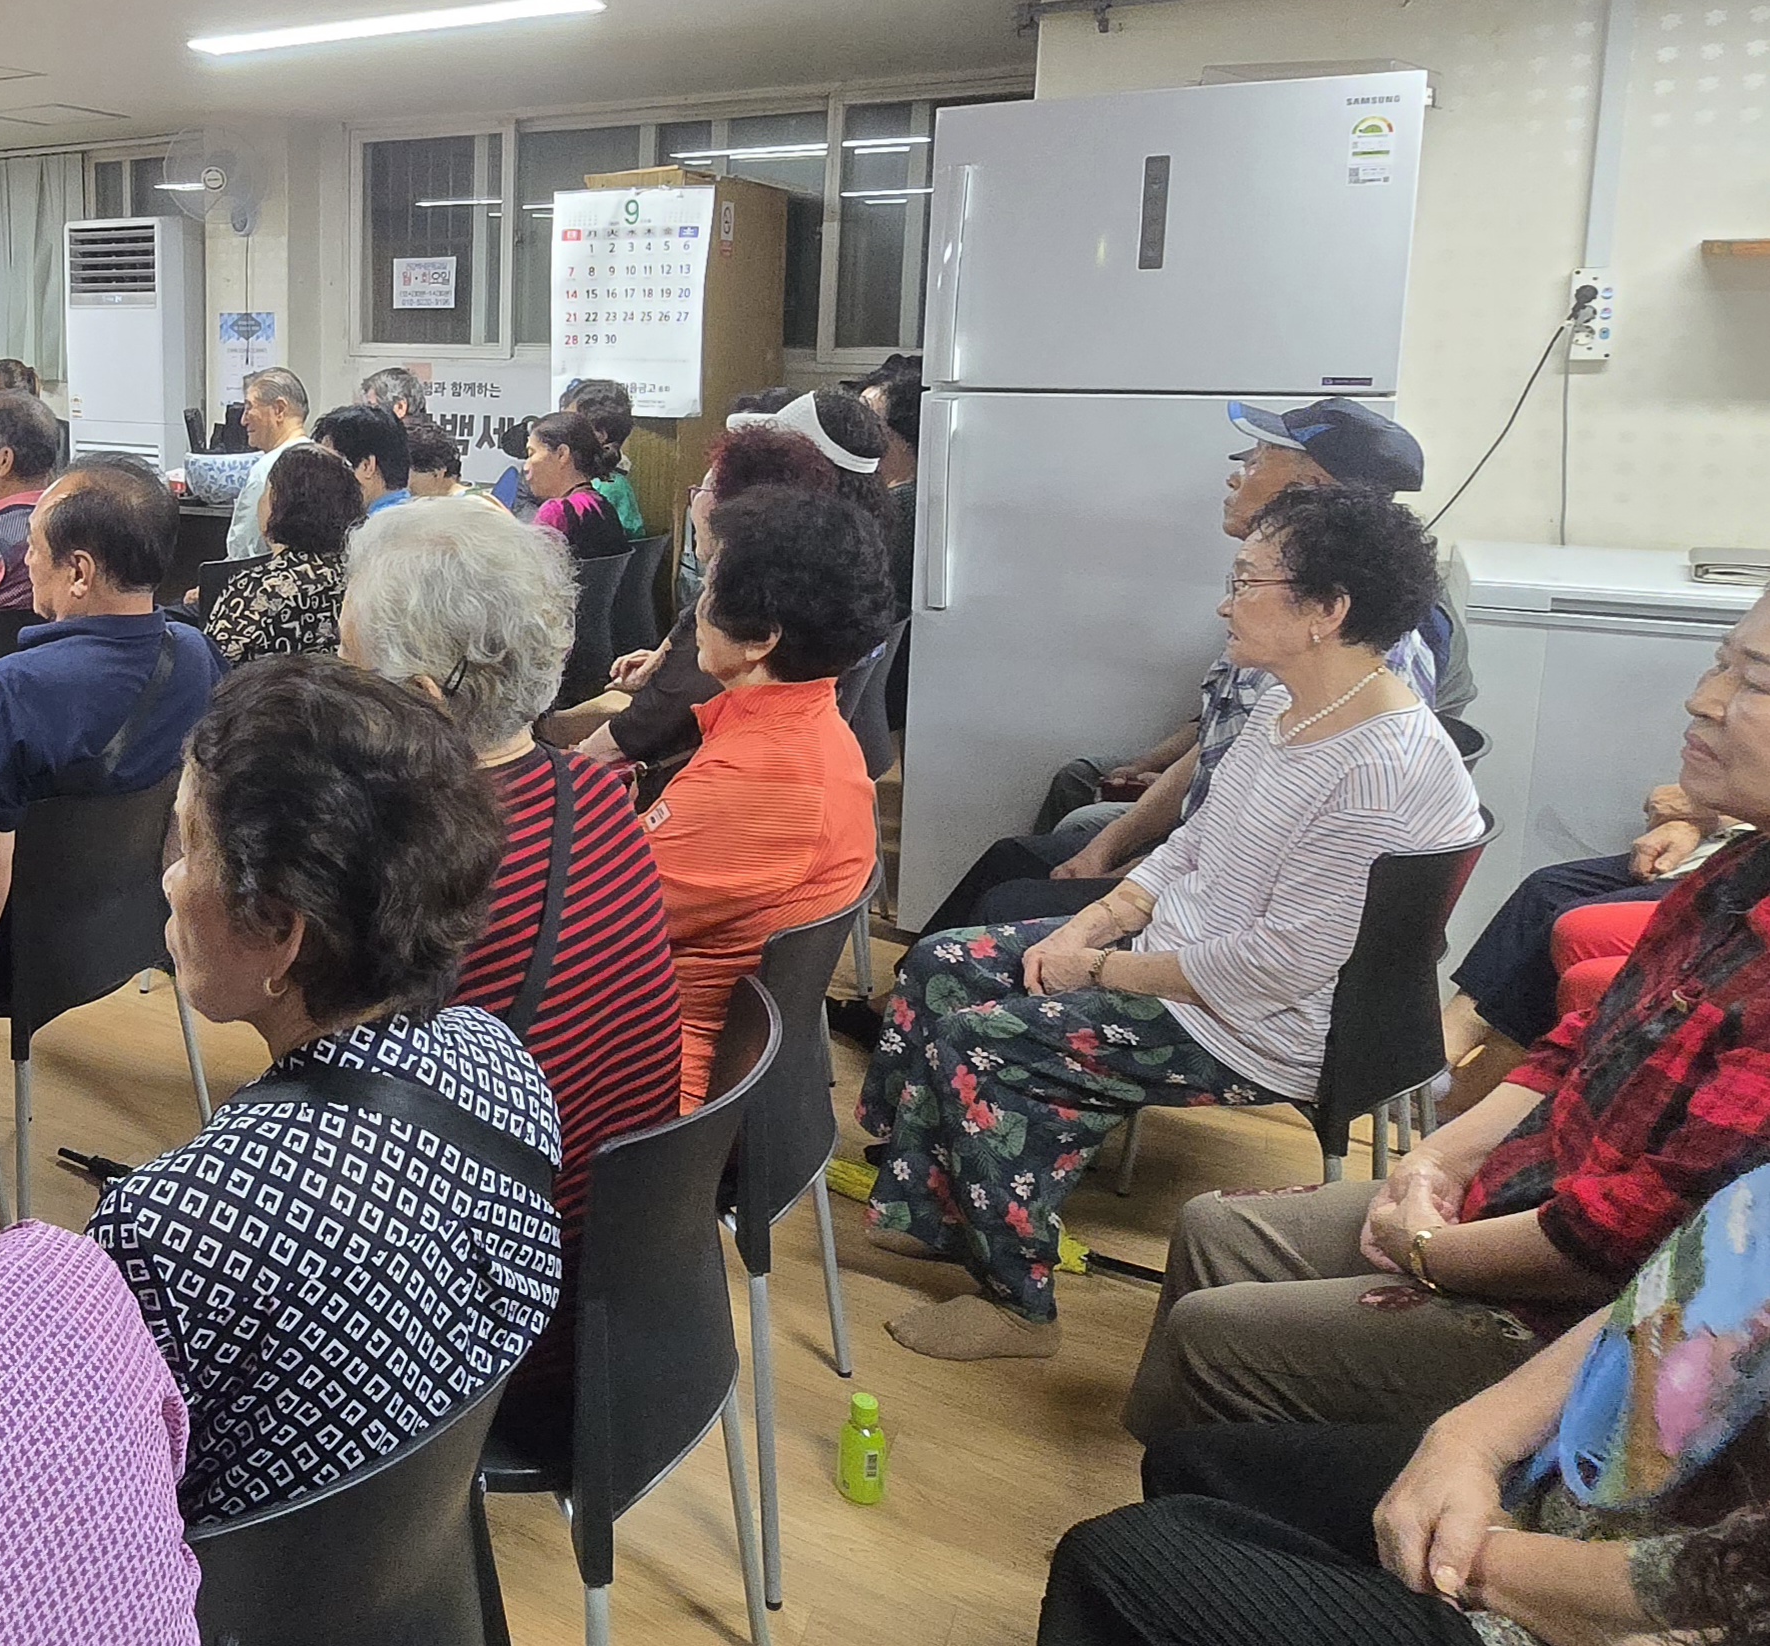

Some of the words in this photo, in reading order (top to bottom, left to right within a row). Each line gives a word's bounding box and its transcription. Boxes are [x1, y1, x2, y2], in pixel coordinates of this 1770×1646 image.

[1346, 95, 1401, 105] SAMSUNG
[624, 199, 640, 225] 9
[608, 242, 616, 253] 2
[628, 242, 635, 252] 3
[645, 242, 652, 251] 4
[663, 241, 670, 251] 5
[683, 240, 690, 250] 6
[568, 266, 575, 277] 7
[588, 266, 595, 277] 8
[608, 266, 616, 276] 9
[626, 265, 636, 275] 10
[643, 265, 653, 275] 11
[660, 264, 672, 274] 12
[679, 264, 691, 274] 13
[566, 290, 578, 299] 14
[585, 289, 598, 299] 15
[606, 288, 617, 299] 16
[624, 288, 636, 298] 17
[642, 288, 654, 298] 18
[660, 288, 672, 298] 19
[677, 287, 691, 298] 20
[566, 312, 577, 322] 21
[584, 312, 598, 322] 22
[605, 311, 617, 321] 23
[622, 311, 634, 322] 24
[640, 311, 652, 322] 25
[658, 311, 671, 322] 26
[676, 311, 689, 322] 27
[564, 335, 579, 345] 28
[584, 334, 598, 344] 29
[605, 334, 617, 344] 30
[450, 381, 502, 398] 함께하는
[439, 413, 540, 456] 백세
